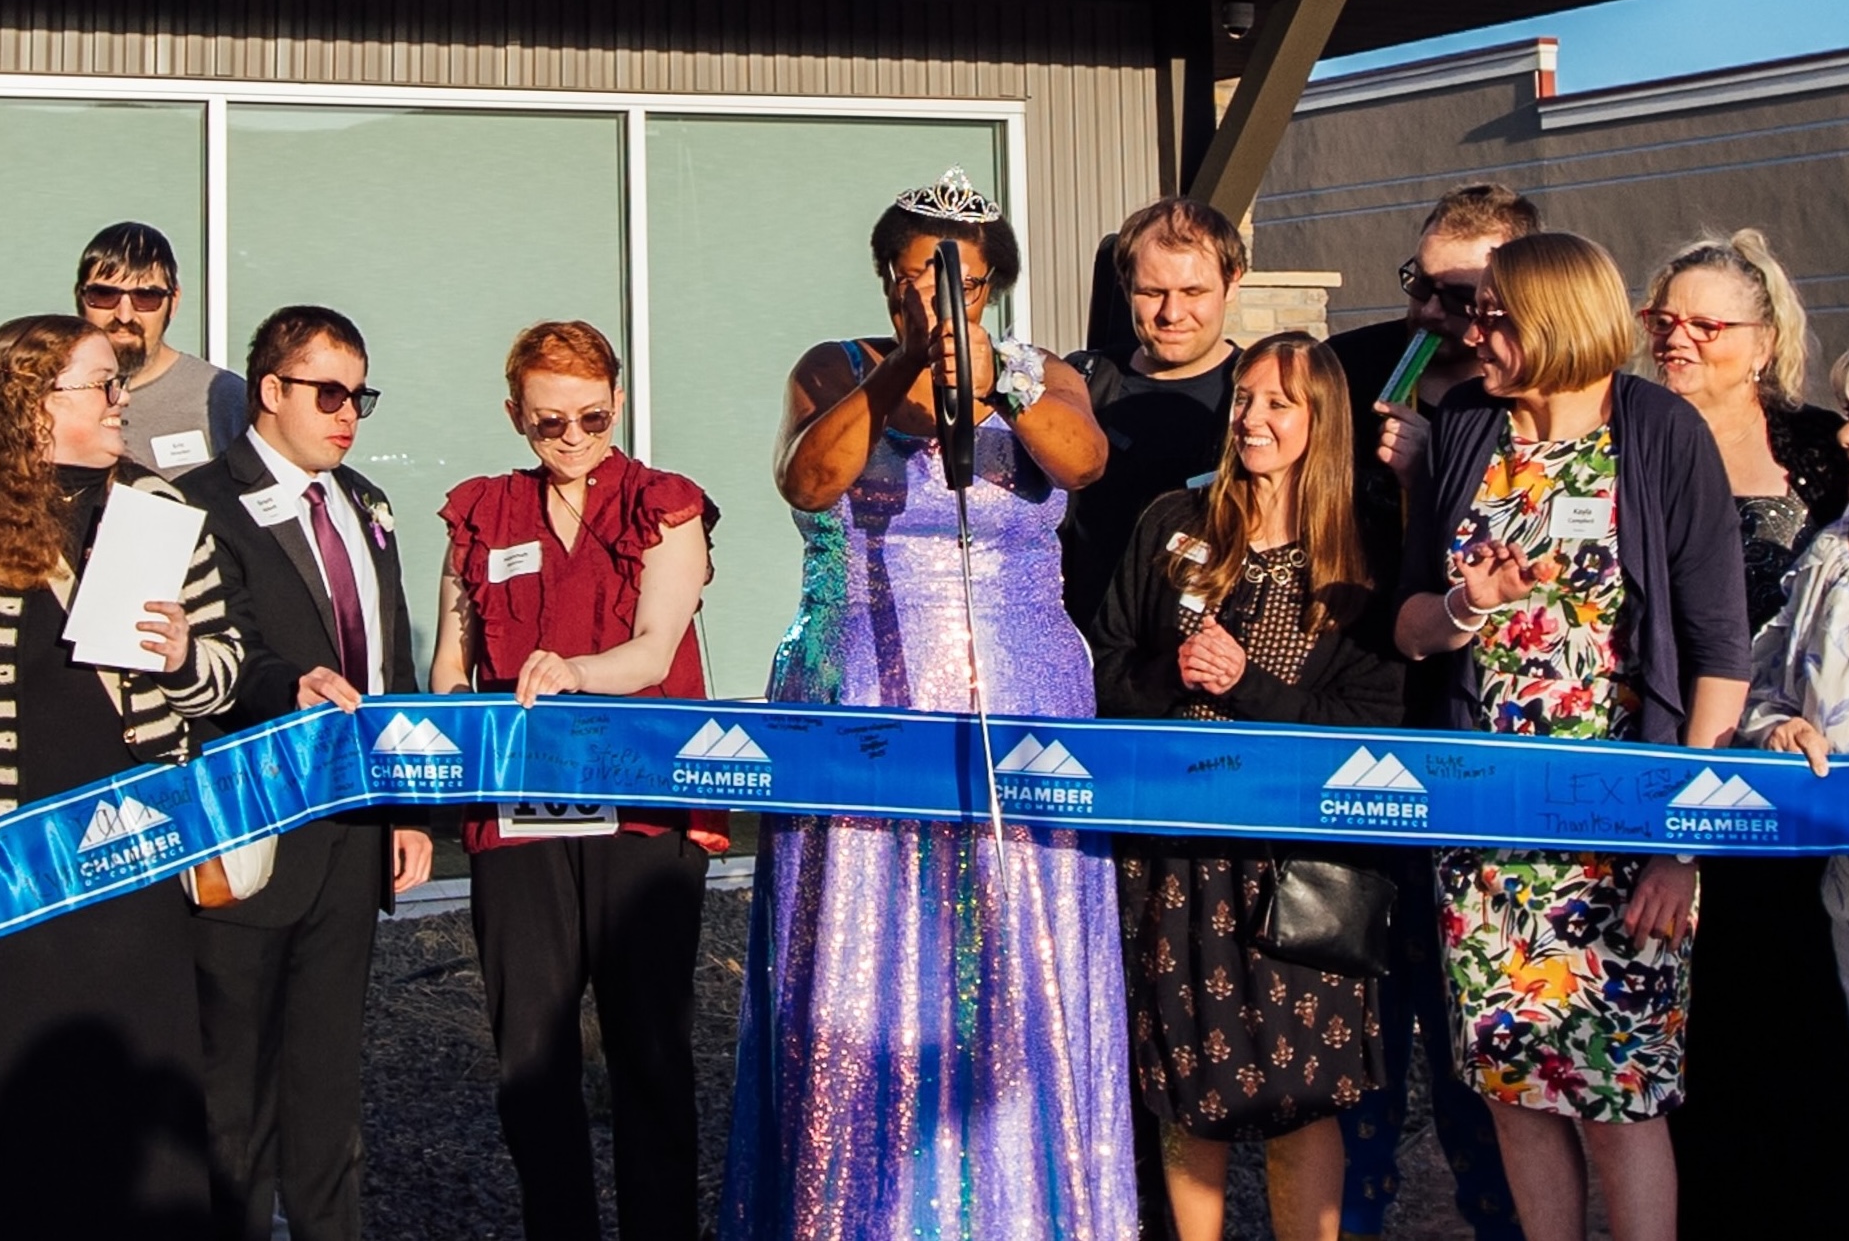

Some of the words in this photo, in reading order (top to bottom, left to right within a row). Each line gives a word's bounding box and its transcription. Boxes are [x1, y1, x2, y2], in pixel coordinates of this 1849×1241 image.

[370, 764, 464, 779] CHAMBER
[672, 769, 772, 788] CHAMBER
[696, 786, 772, 797] COMMERCE
[995, 785, 1093, 805] CHAMBER
[1015, 802, 1093, 813] COMMERCE
[1320, 799, 1428, 818] CHAMBER
[1320, 816, 1337, 824] OF
[1347, 817, 1428, 828] COMMERCE
[1665, 817, 1779, 833] CHAMBER
[1694, 833, 1779, 841] COMMERCE
[80, 832, 182, 877] CHAMBER
